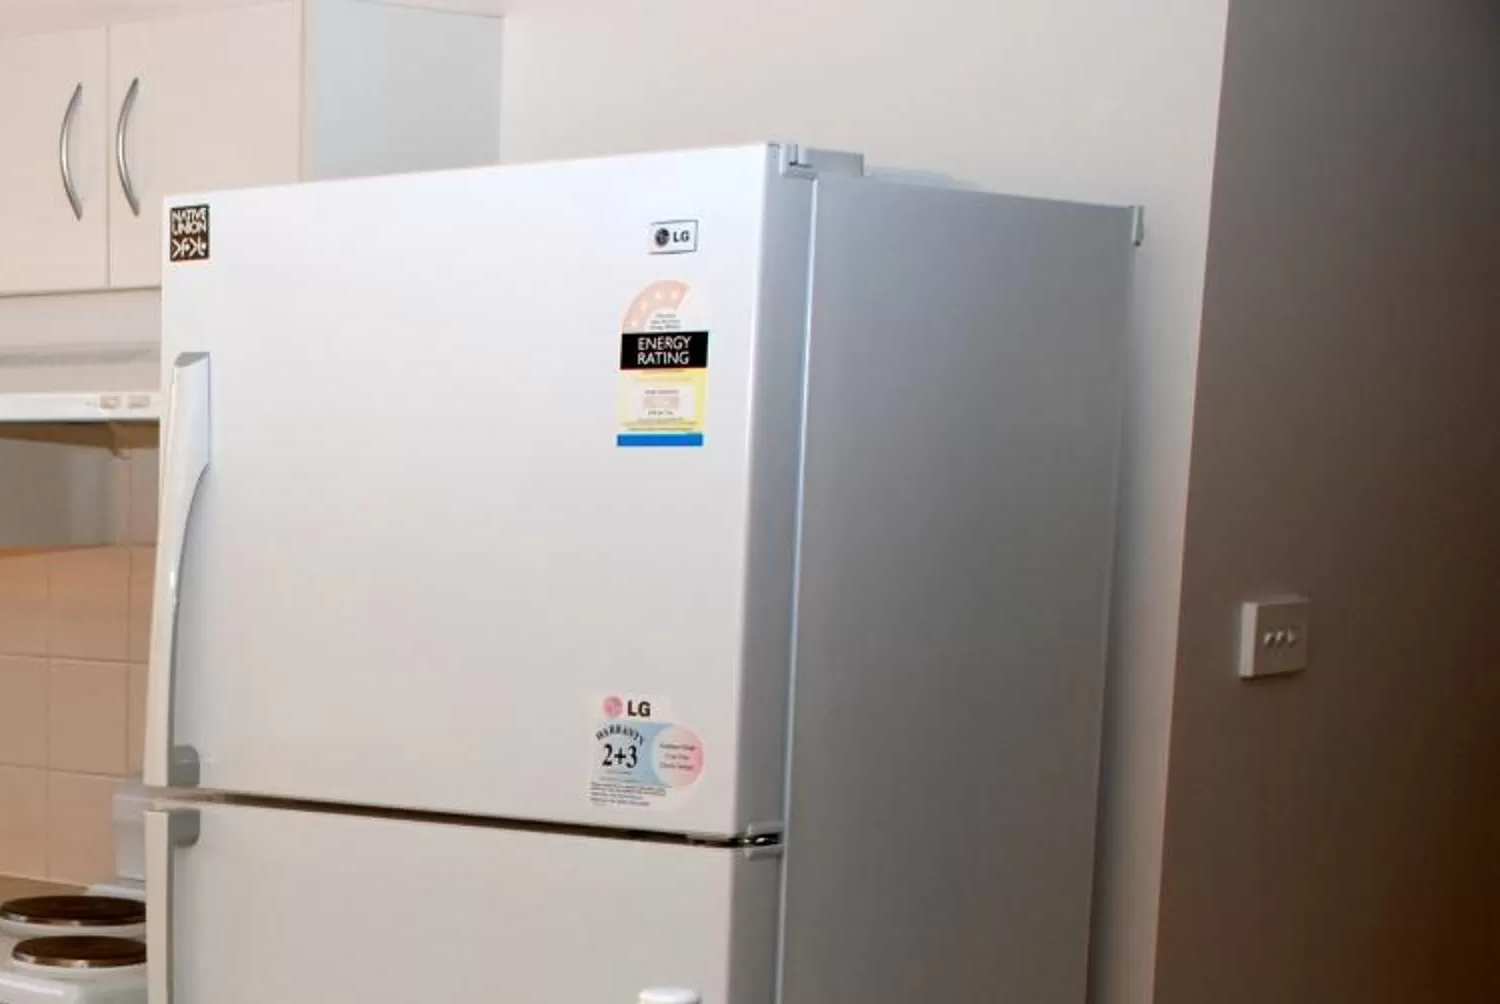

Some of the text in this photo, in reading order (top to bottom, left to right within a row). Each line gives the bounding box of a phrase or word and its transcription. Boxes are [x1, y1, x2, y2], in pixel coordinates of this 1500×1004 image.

[172, 221, 206, 236] UNION
[673, 230, 690, 243] LG
[637, 335, 692, 351] ENERGY
[637, 351, 690, 365] RATING
[627, 700, 651, 717] LG
[596, 724, 644, 746] WARRANTY
[602, 743, 638, 769] 2+3
